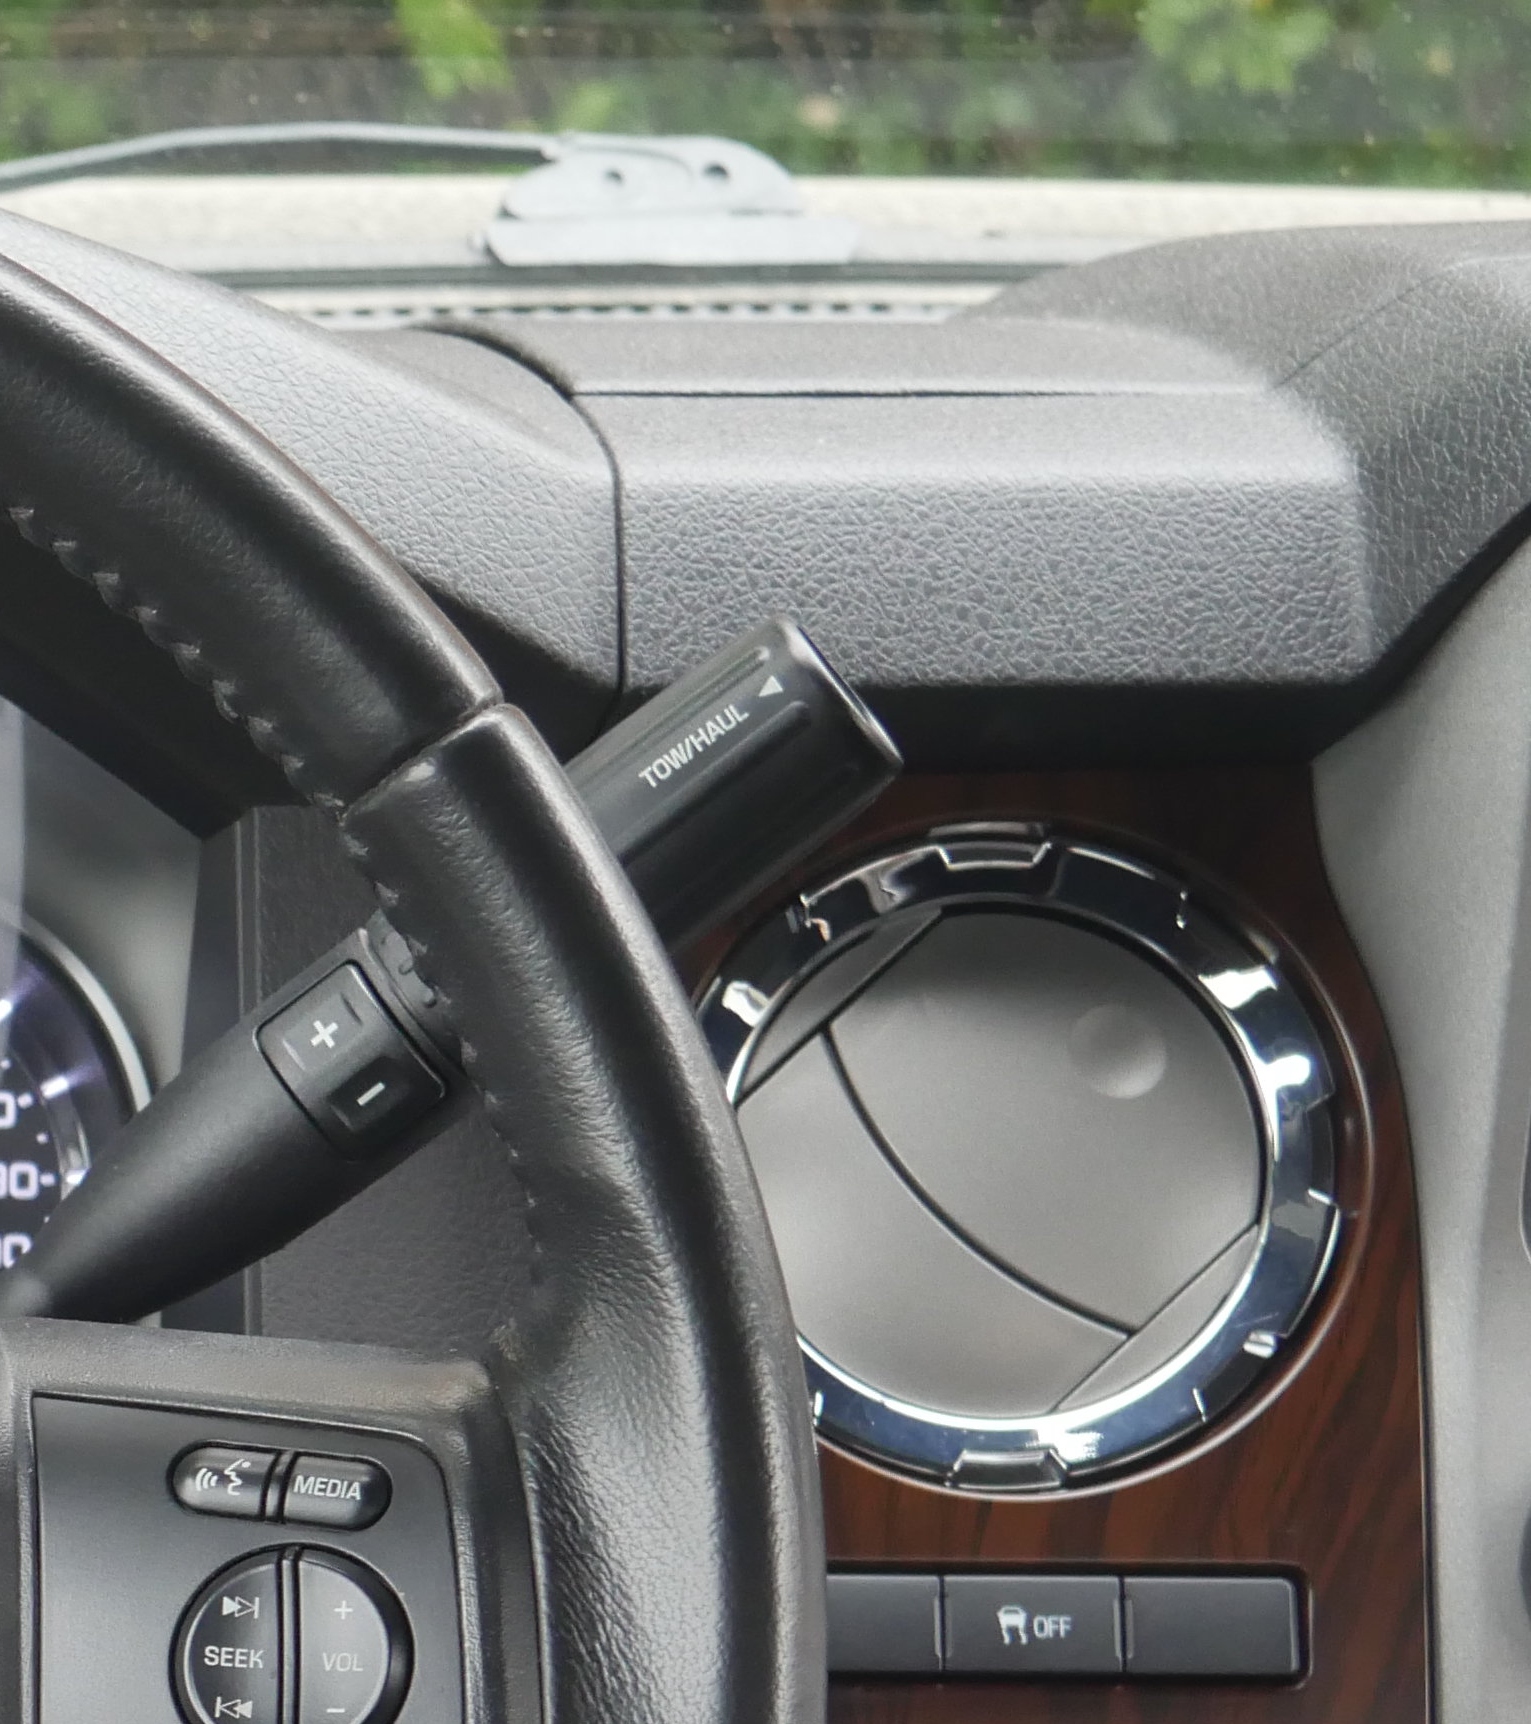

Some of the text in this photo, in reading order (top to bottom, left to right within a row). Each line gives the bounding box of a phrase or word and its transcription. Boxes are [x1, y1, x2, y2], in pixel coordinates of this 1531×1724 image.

[638, 704, 750, 788] TOW/HAUL
[293, 1474, 362, 1501] MEDIA
[1032, 1615, 1072, 1639] OFF
[203, 1645, 265, 1670] SEEK
[321, 1651, 365, 1673] VOL
